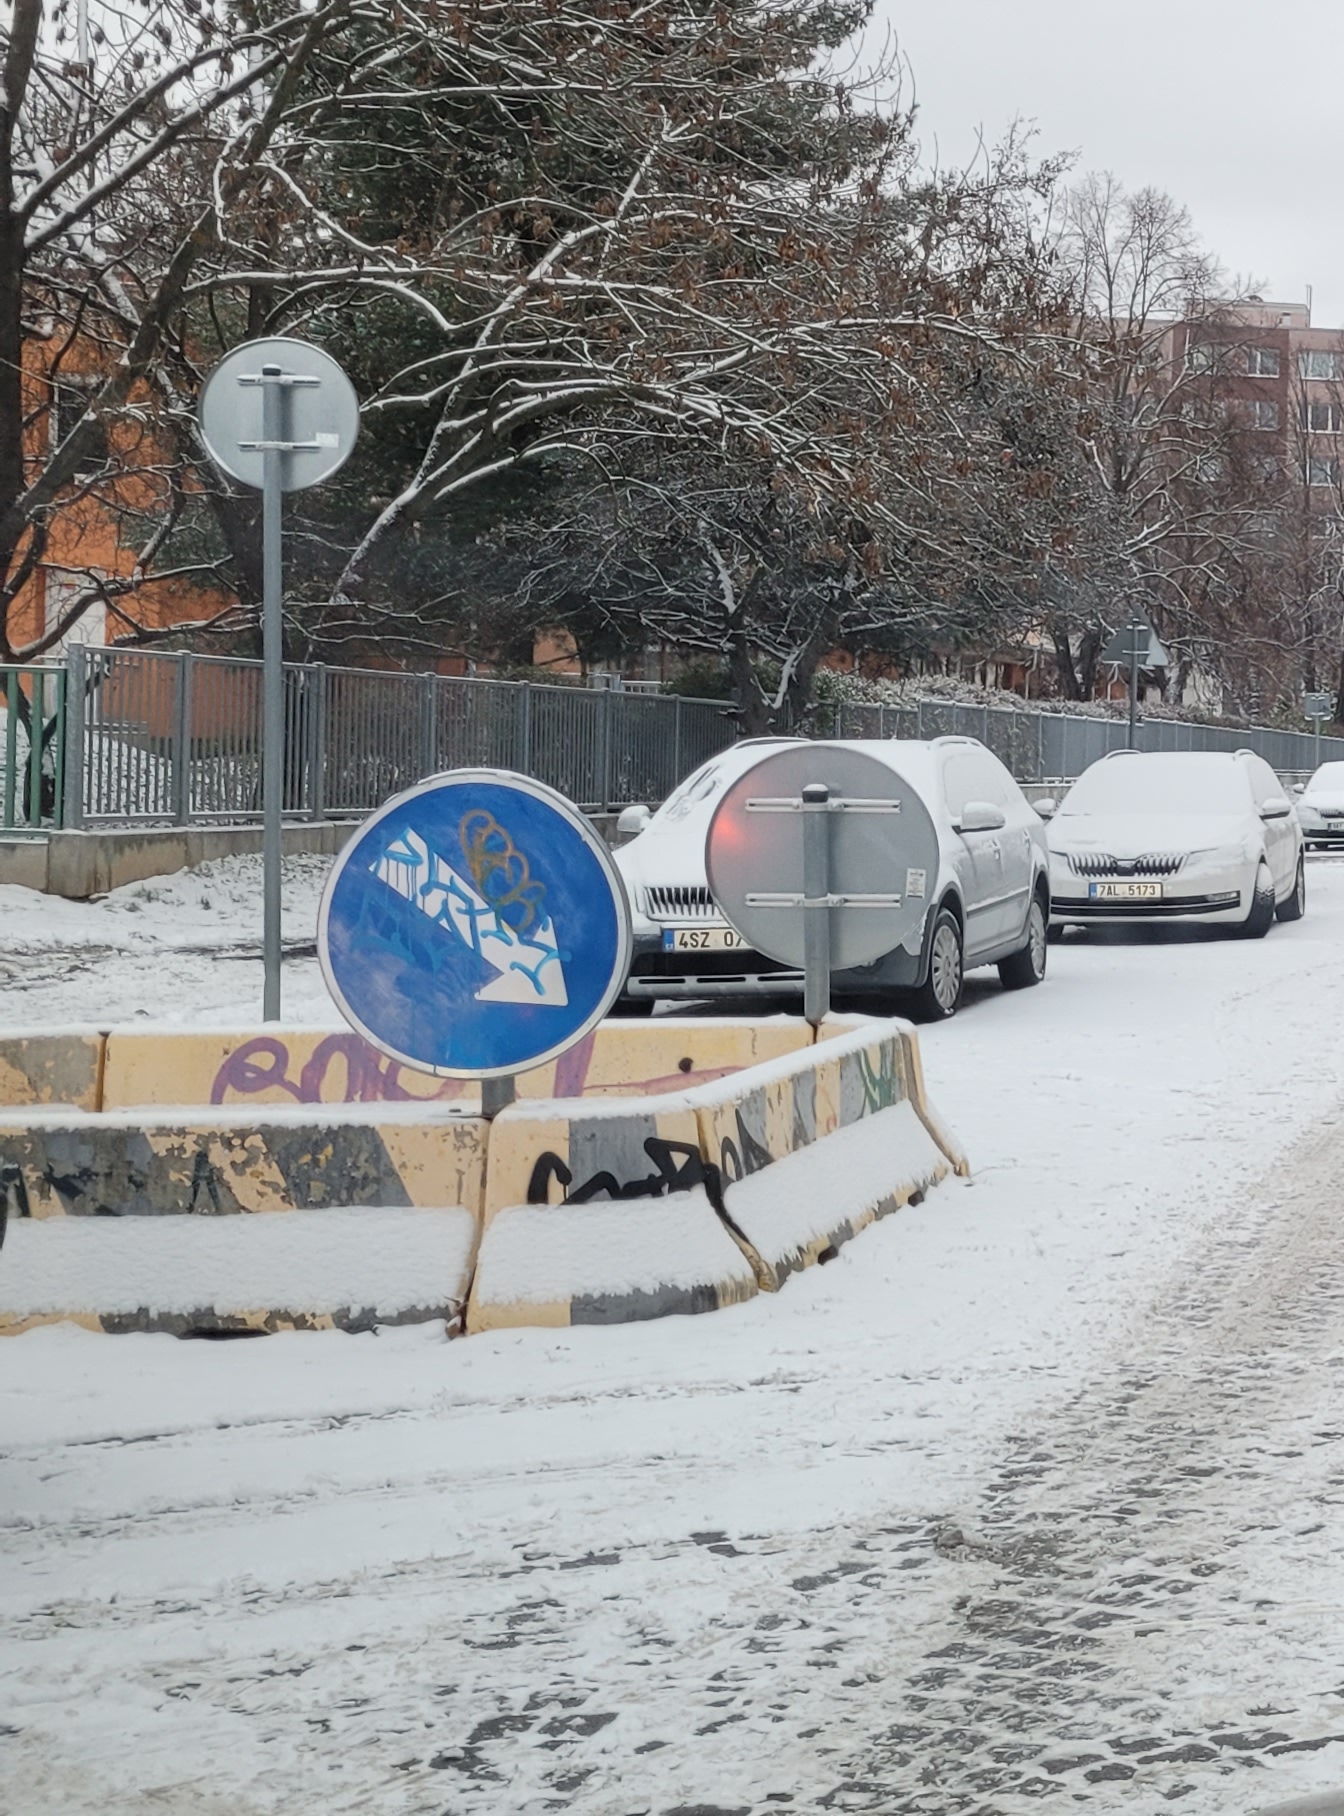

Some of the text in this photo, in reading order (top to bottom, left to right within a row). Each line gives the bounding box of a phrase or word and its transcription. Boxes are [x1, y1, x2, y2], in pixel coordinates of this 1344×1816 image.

[1099, 884, 1156, 897] 7AL 5173
[678, 931, 710, 948] 4SZ
